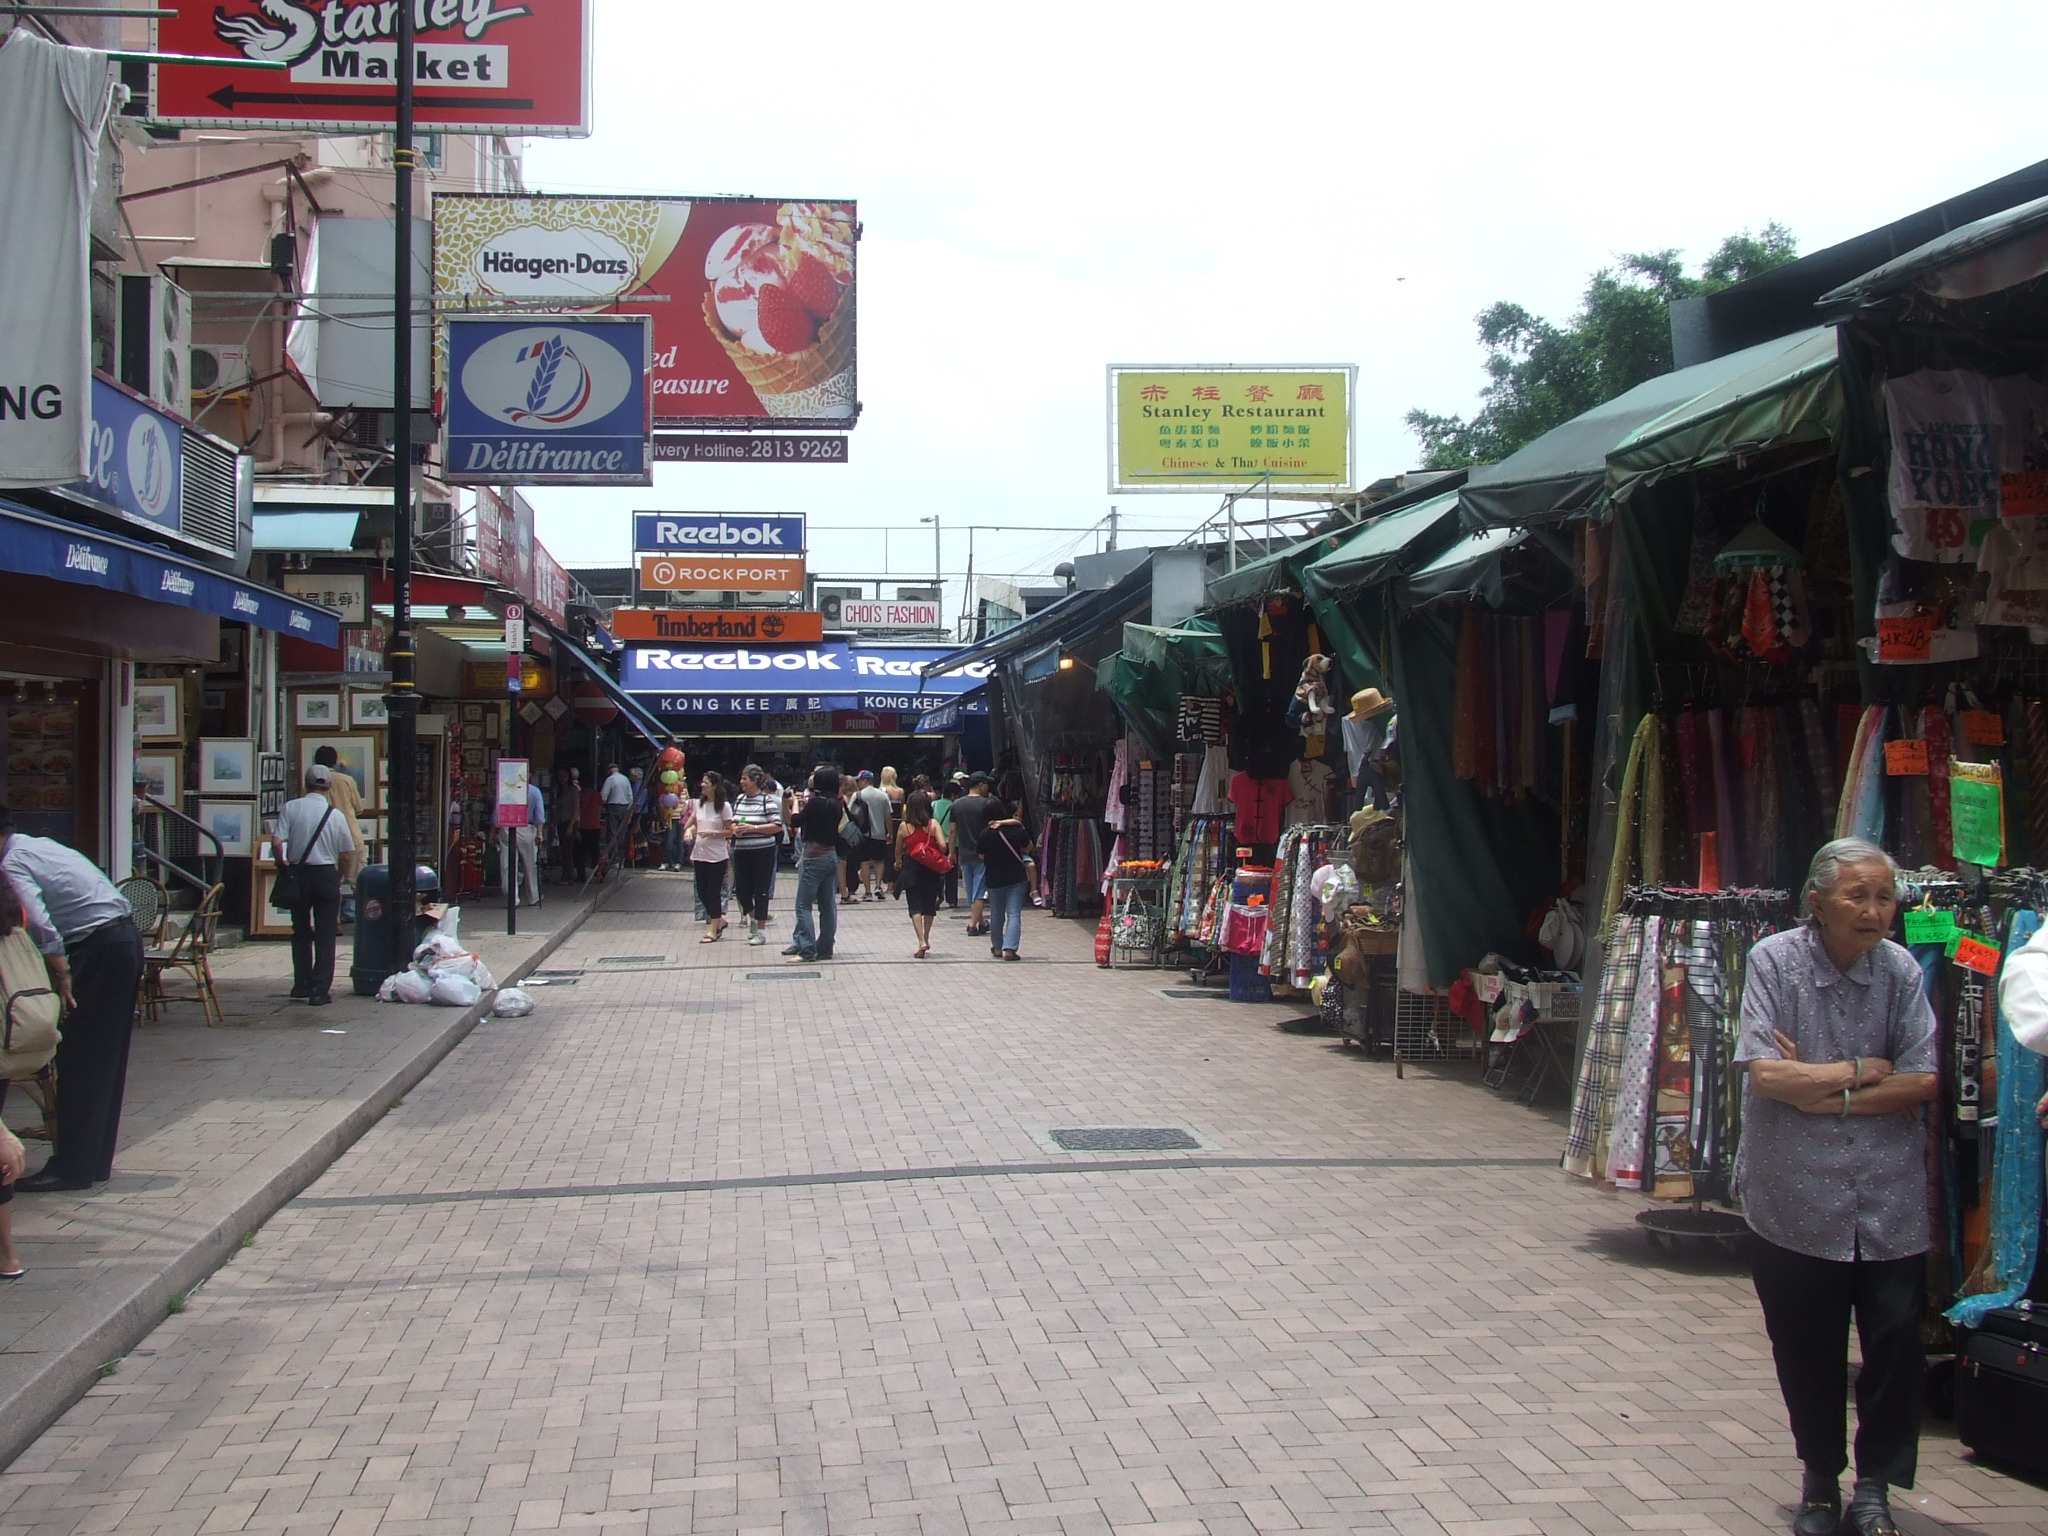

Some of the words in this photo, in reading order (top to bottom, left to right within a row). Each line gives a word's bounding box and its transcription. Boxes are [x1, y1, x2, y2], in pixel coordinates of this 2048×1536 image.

[321, 50, 493, 81] Maket
[482, 250, 629, 279] Häagen-Dazs
[1140, 384, 1325, 402] 赤柱餐廳
[1142, 405, 1212, 421] Stanley
[1222, 404, 1326, 418] Restaurant
[464, 440, 624, 472] Délifrance
[694, 442, 749, 458] Hotline:
[751, 440, 795, 458] 2813
[799, 440, 843, 458] 9262
[1162, 456, 1209, 469] Chinese
[1215, 457, 1225, 468] &
[1263, 457, 1308, 469] Cuisine
[656, 521, 784, 546] Reebok
[679, 567, 789, 581] ROCKPORT
[845, 603, 882, 624] CHOI'S
[886, 604, 936, 624] FASHION
[652, 613, 757, 638] Timberland
[635, 648, 842, 671] Reebok
[661, 698, 719, 711] KONG
[730, 698, 770, 711] KEE
[864, 695, 909, 710] KONG
[845, 719, 875, 730] PUMA
